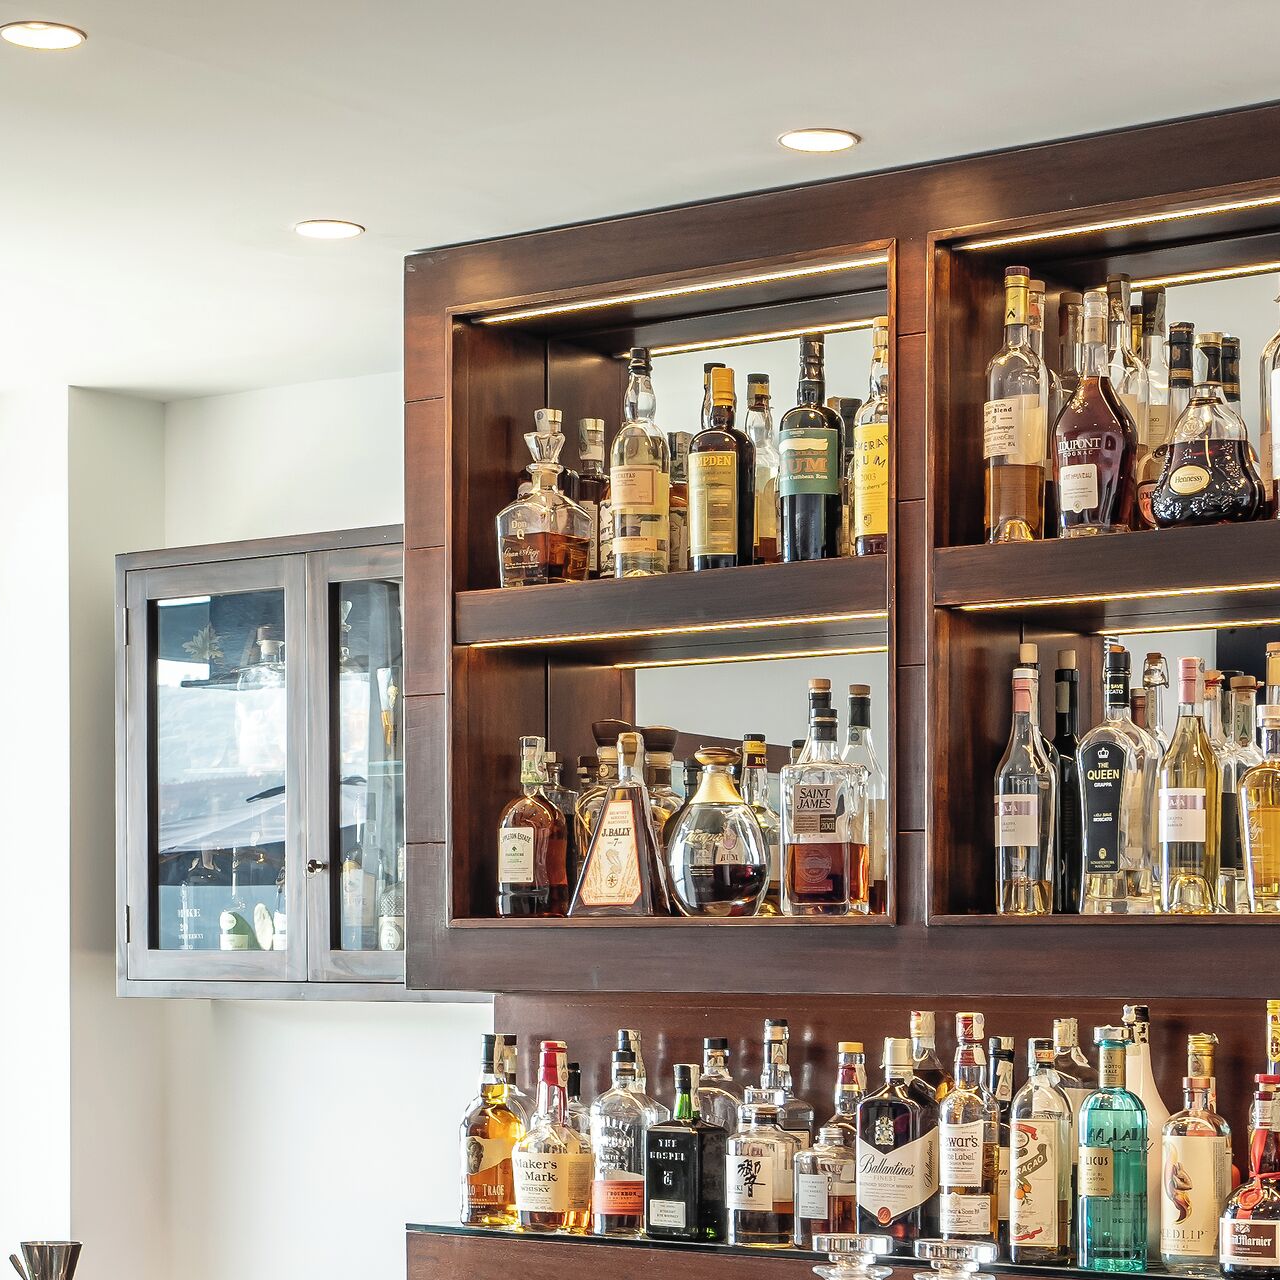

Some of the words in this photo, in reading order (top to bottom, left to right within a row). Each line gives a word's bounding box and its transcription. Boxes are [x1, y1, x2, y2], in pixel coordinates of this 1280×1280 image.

[1063, 449, 1093, 457] COGNAC
[1175, 475, 1203, 484] Hennessy
[511, 521, 527, 529] Don
[517, 528, 524, 540] Q
[755, 756, 765, 764] RU
[1087, 769, 1119, 780] QUEEN
[799, 788, 830, 799] SAINT
[797, 799, 832, 809] JAMES
[821, 822, 835, 830] 2001
[613, 838, 618, 846] 7
[720, 853, 739, 862] RUM
[658, 1139, 677, 1148] THE
[650, 1151, 685, 1161] GOSPEL
[954, 1152, 975, 1161] Label
[859, 1153, 915, 1175] Ballantine's
[1017, 1154, 1044, 1175] RAÇAO
[1086, 1156, 1108, 1166] LICUS
[525, 1172, 558, 1182] Mark
